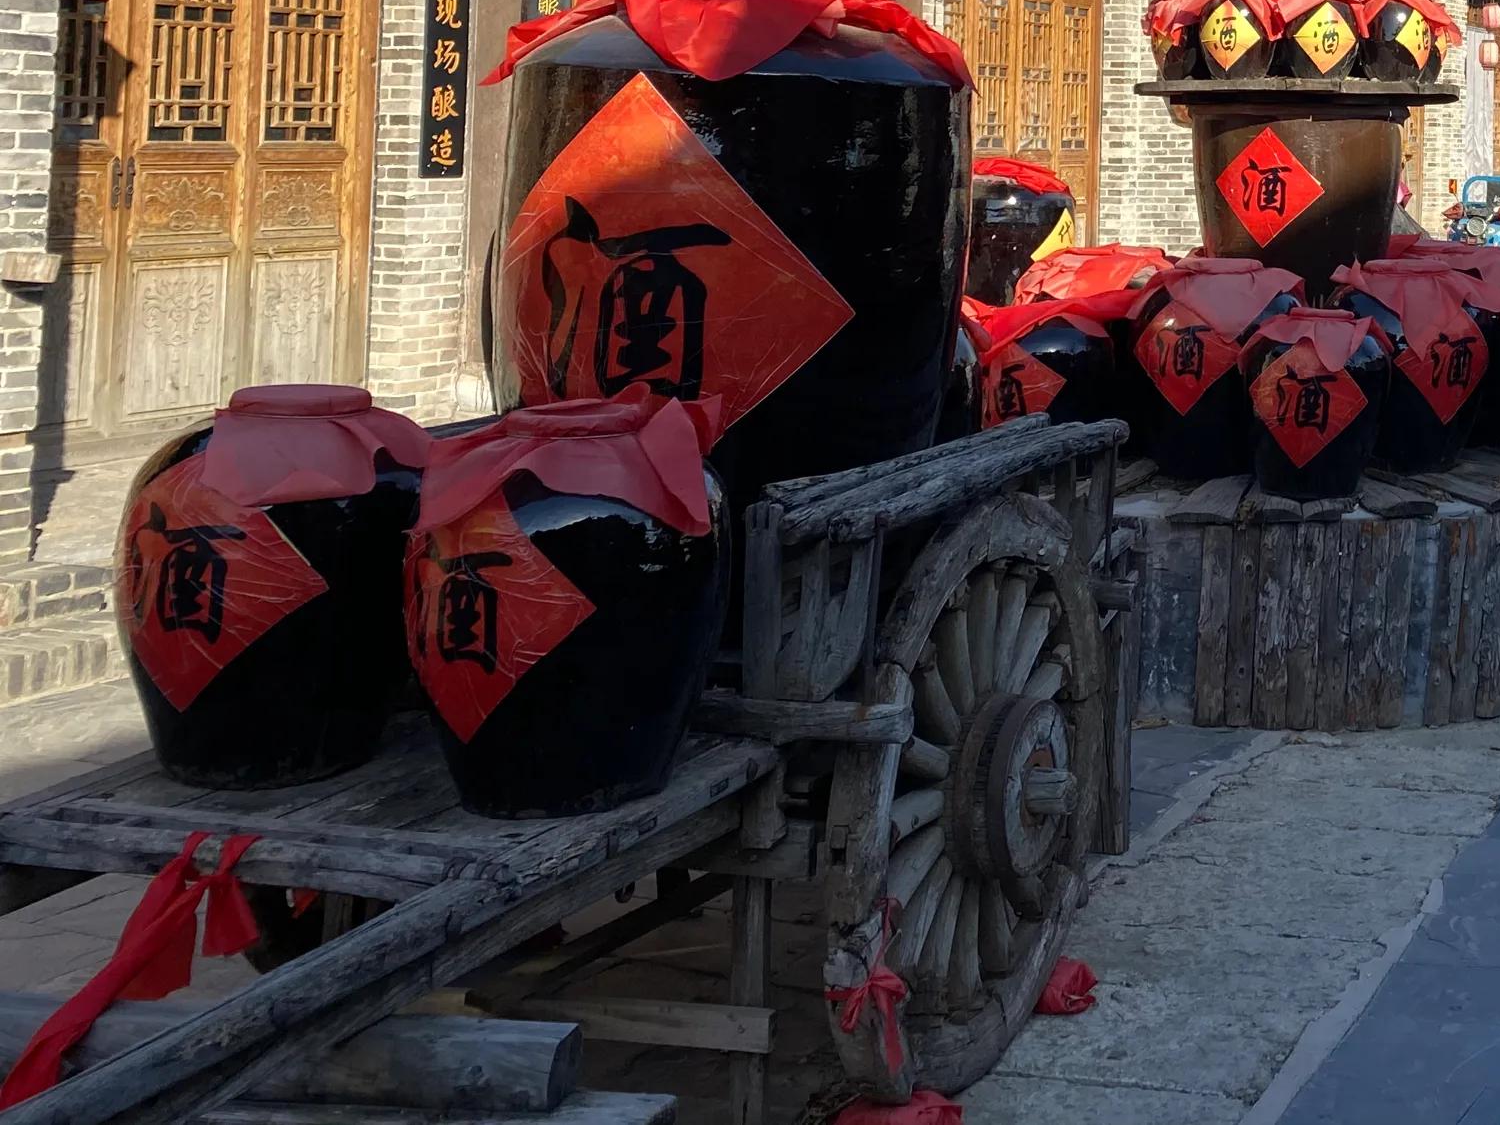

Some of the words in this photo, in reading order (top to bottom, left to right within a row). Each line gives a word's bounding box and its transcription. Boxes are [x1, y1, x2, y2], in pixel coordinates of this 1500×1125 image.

[1212, 16, 1237, 52] 酒
[1313, 19, 1339, 55] 酒
[1240, 158, 1293, 216] 酒
[542, 196, 732, 400] 酒
[1156, 325, 1214, 380] 酒
[1431, 333, 1477, 390] 酒
[1276, 364, 1338, 433] 酒
[130, 502, 247, 644] 酒
[415, 535, 513, 673] 酒
